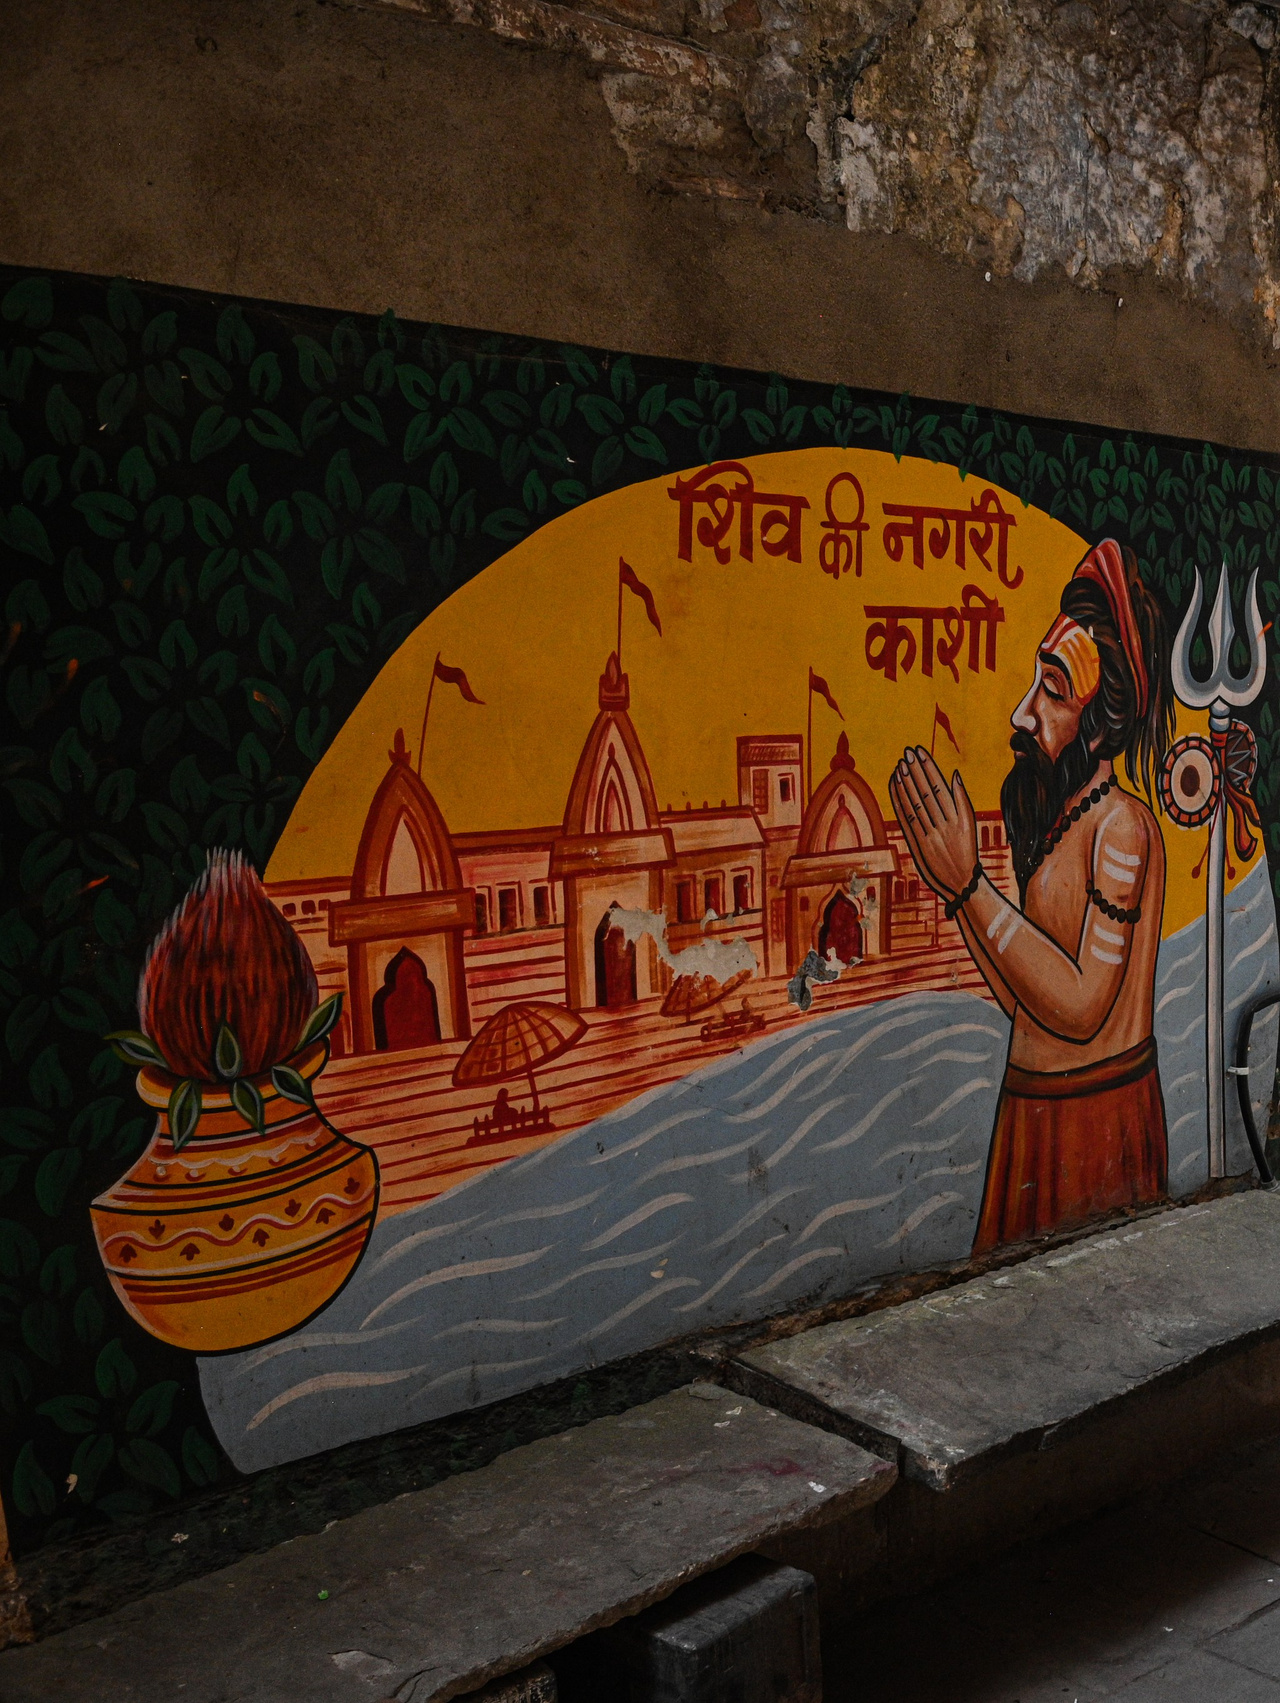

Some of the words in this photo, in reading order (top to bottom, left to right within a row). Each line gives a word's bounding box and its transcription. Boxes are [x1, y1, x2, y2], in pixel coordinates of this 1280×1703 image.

[667, 461, 811, 565] शिव
[818, 471, 871, 579] की
[881, 488, 1025, 589] नगरी
[862, 583, 1006, 684] काशी
